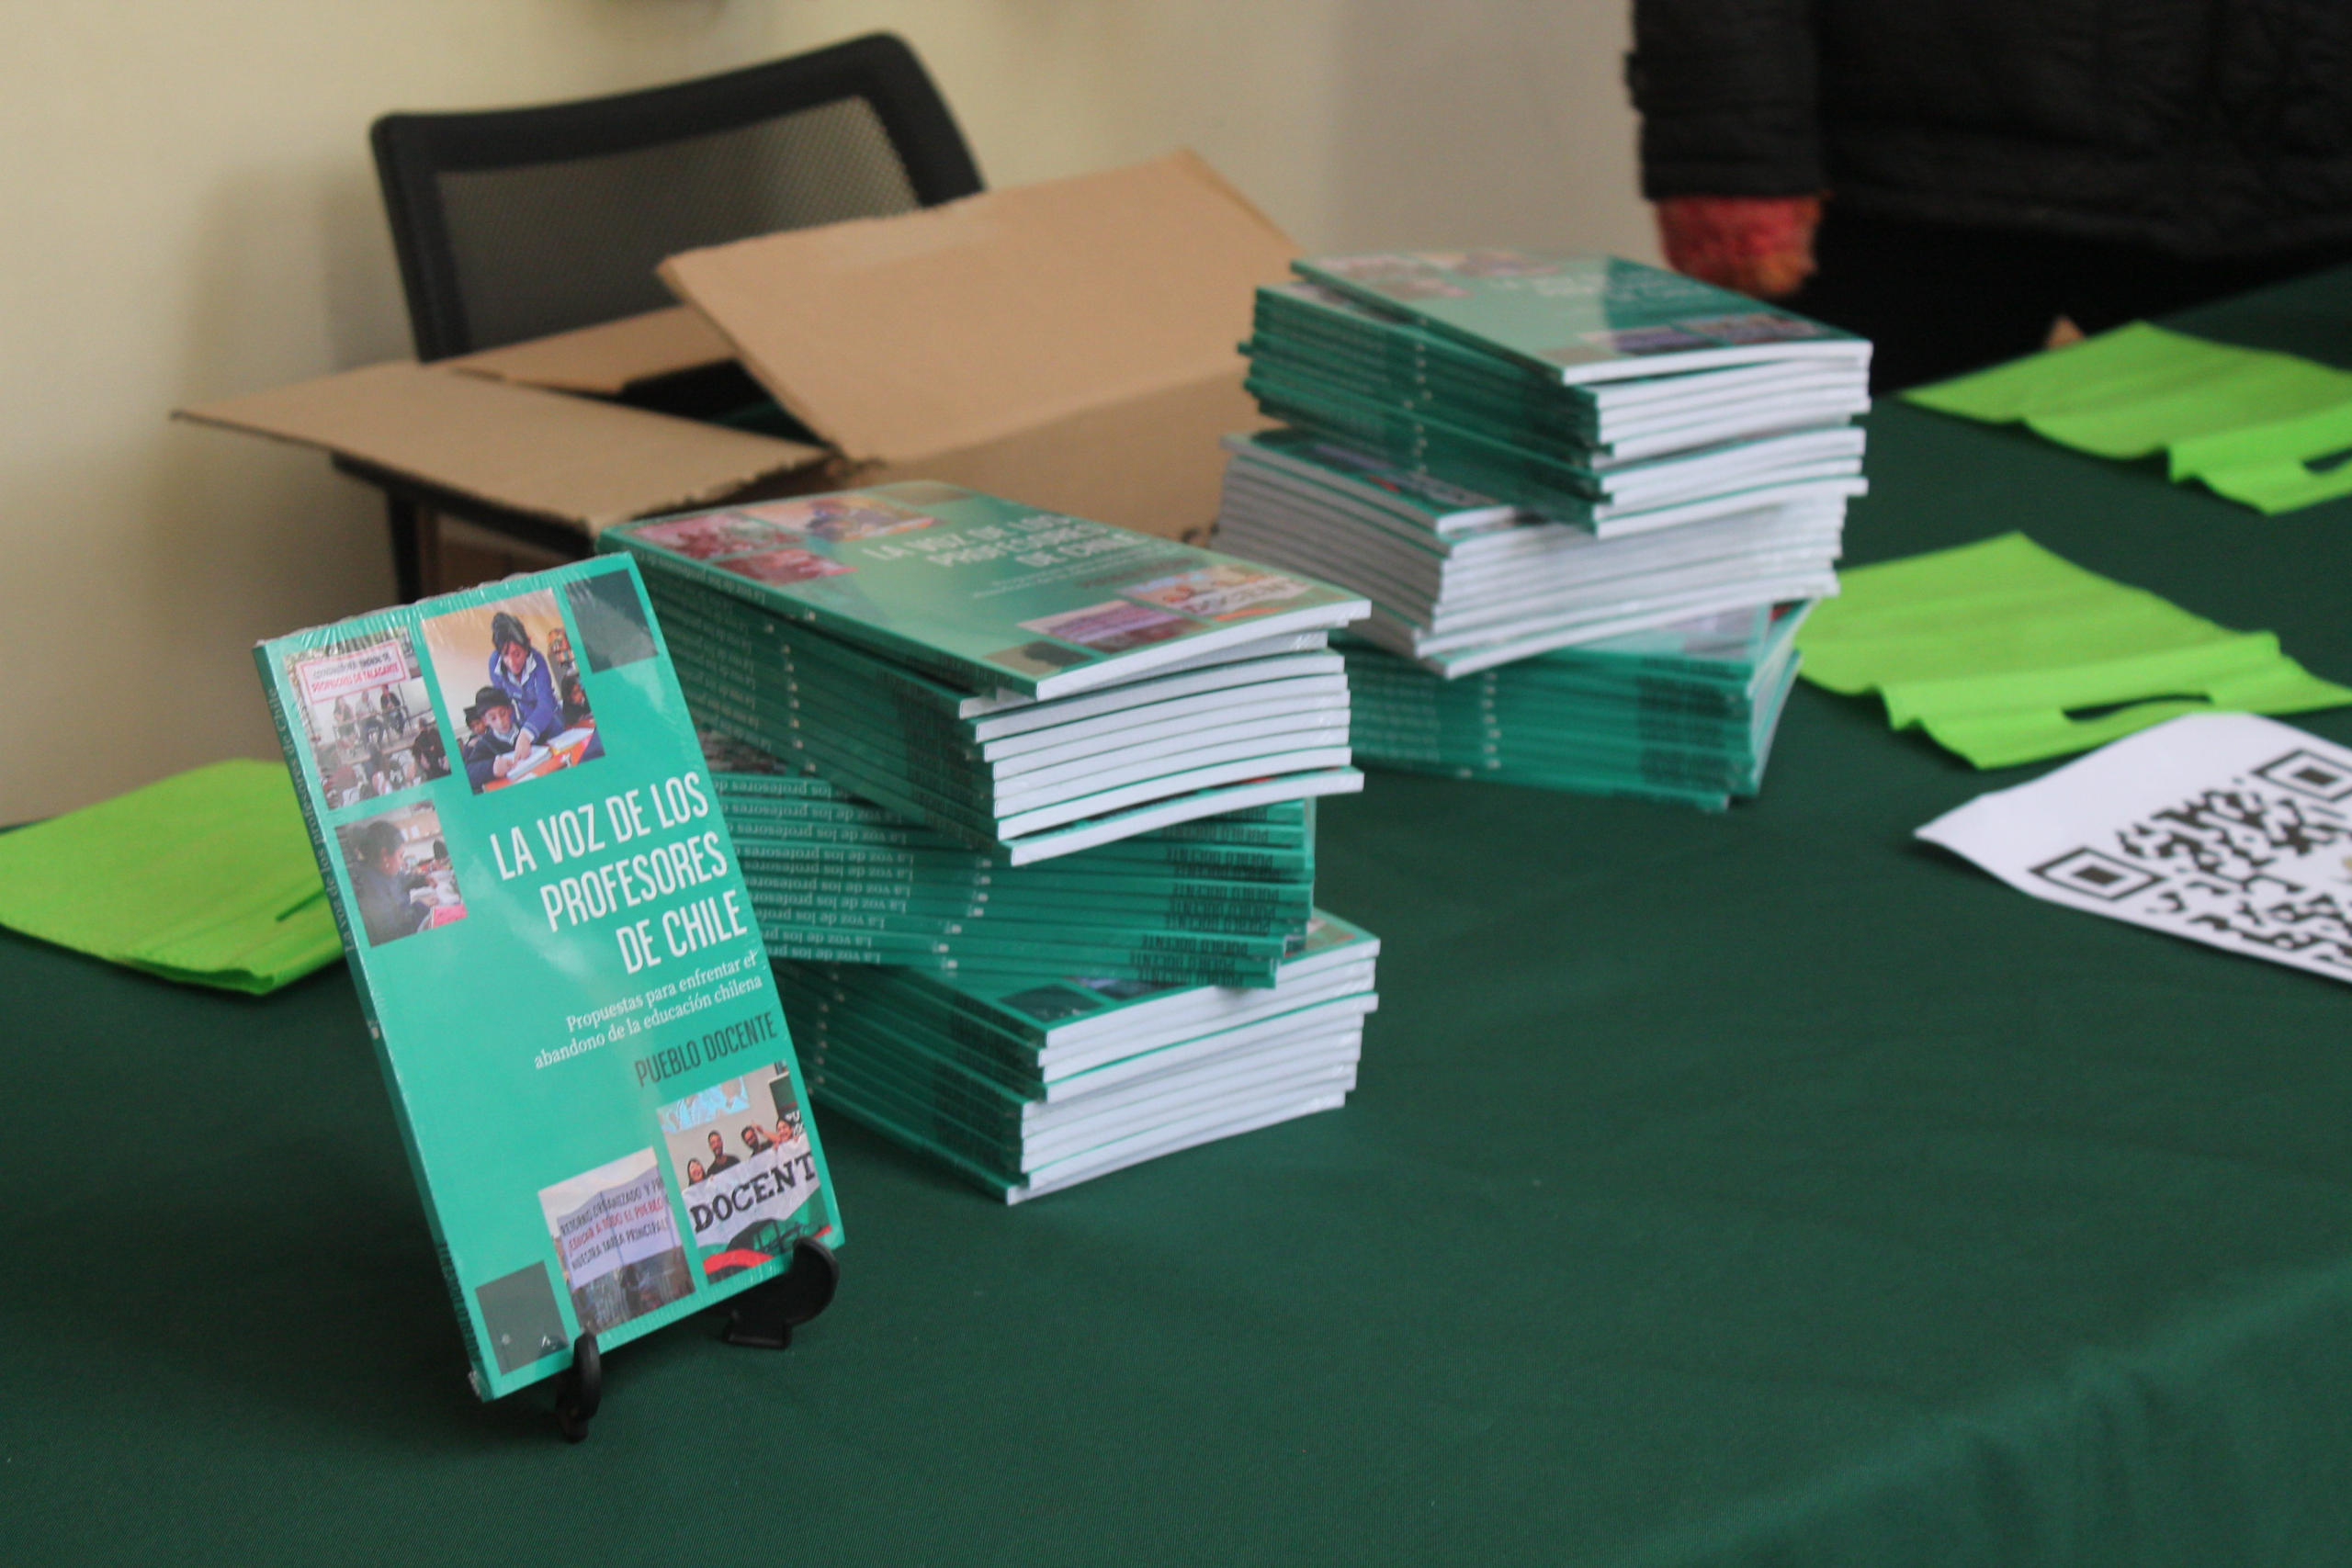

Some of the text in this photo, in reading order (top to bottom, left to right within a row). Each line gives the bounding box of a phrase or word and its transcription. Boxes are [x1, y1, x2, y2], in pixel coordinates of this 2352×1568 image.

[490, 772, 708, 881] LA VOZ DE LOS
[539, 831, 728, 932] PROFESORES
[616, 890, 747, 975] DE CHILE
[535, 976, 763, 1069] abandono de la educación chilena
[566, 994, 643, 1032] Propuestas
[645, 983, 678, 1009] para
[679, 958, 741, 991] enfrentar
[743, 949, 757, 969] el
[634, 1011, 778, 1088] PUEBLO DOCENTE
[690, 1152, 816, 1234] DOCENT
